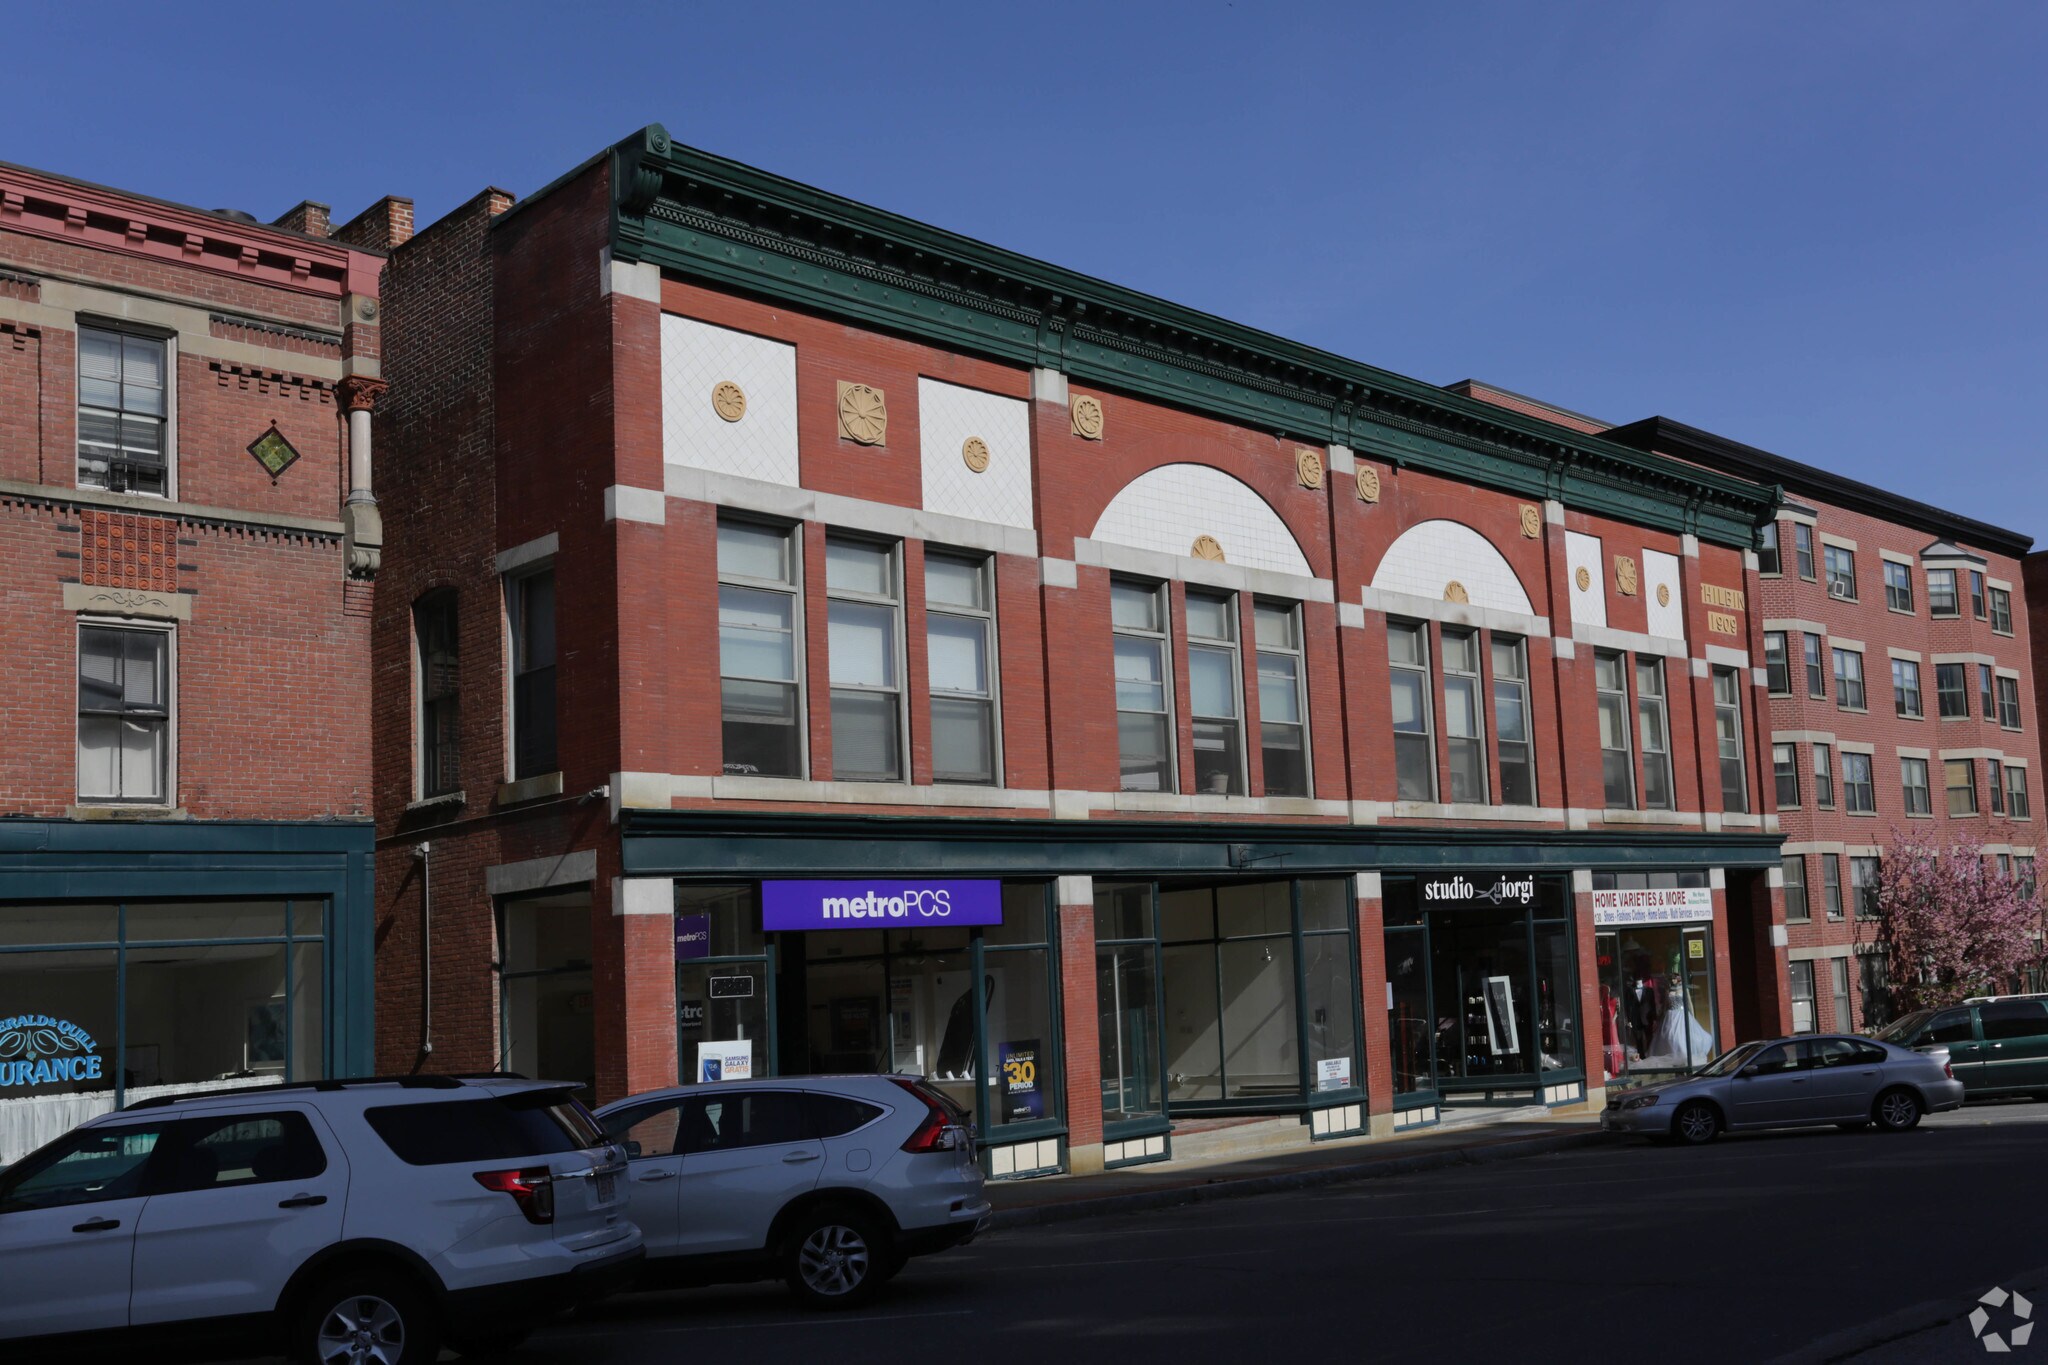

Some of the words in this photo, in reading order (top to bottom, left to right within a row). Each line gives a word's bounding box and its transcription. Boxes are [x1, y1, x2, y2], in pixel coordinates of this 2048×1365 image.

[1703, 585, 1745, 609] HILBIN
[1710, 613, 1737, 634] 1909
[1425, 876, 1474, 900] studio
[1492, 874, 1534, 904] giorgi
[1594, 893, 1617, 908] HOME
[1618, 891, 1657, 907] VARIETIES
[1658, 891, 1665, 906] &
[1665, 890, 1686, 906] MORE
[822, 889, 951, 919] metroPCS
[677, 931, 707, 942] metroPCS
[57, 1020, 97, 1053] QUILL
[1006, 1051, 1035, 1059] UNLIMITED
[0, 1055, 102, 1086] URANCE
[1003, 1061, 1035, 1084] $30
[1009, 1082, 1034, 1090] PERIOD
